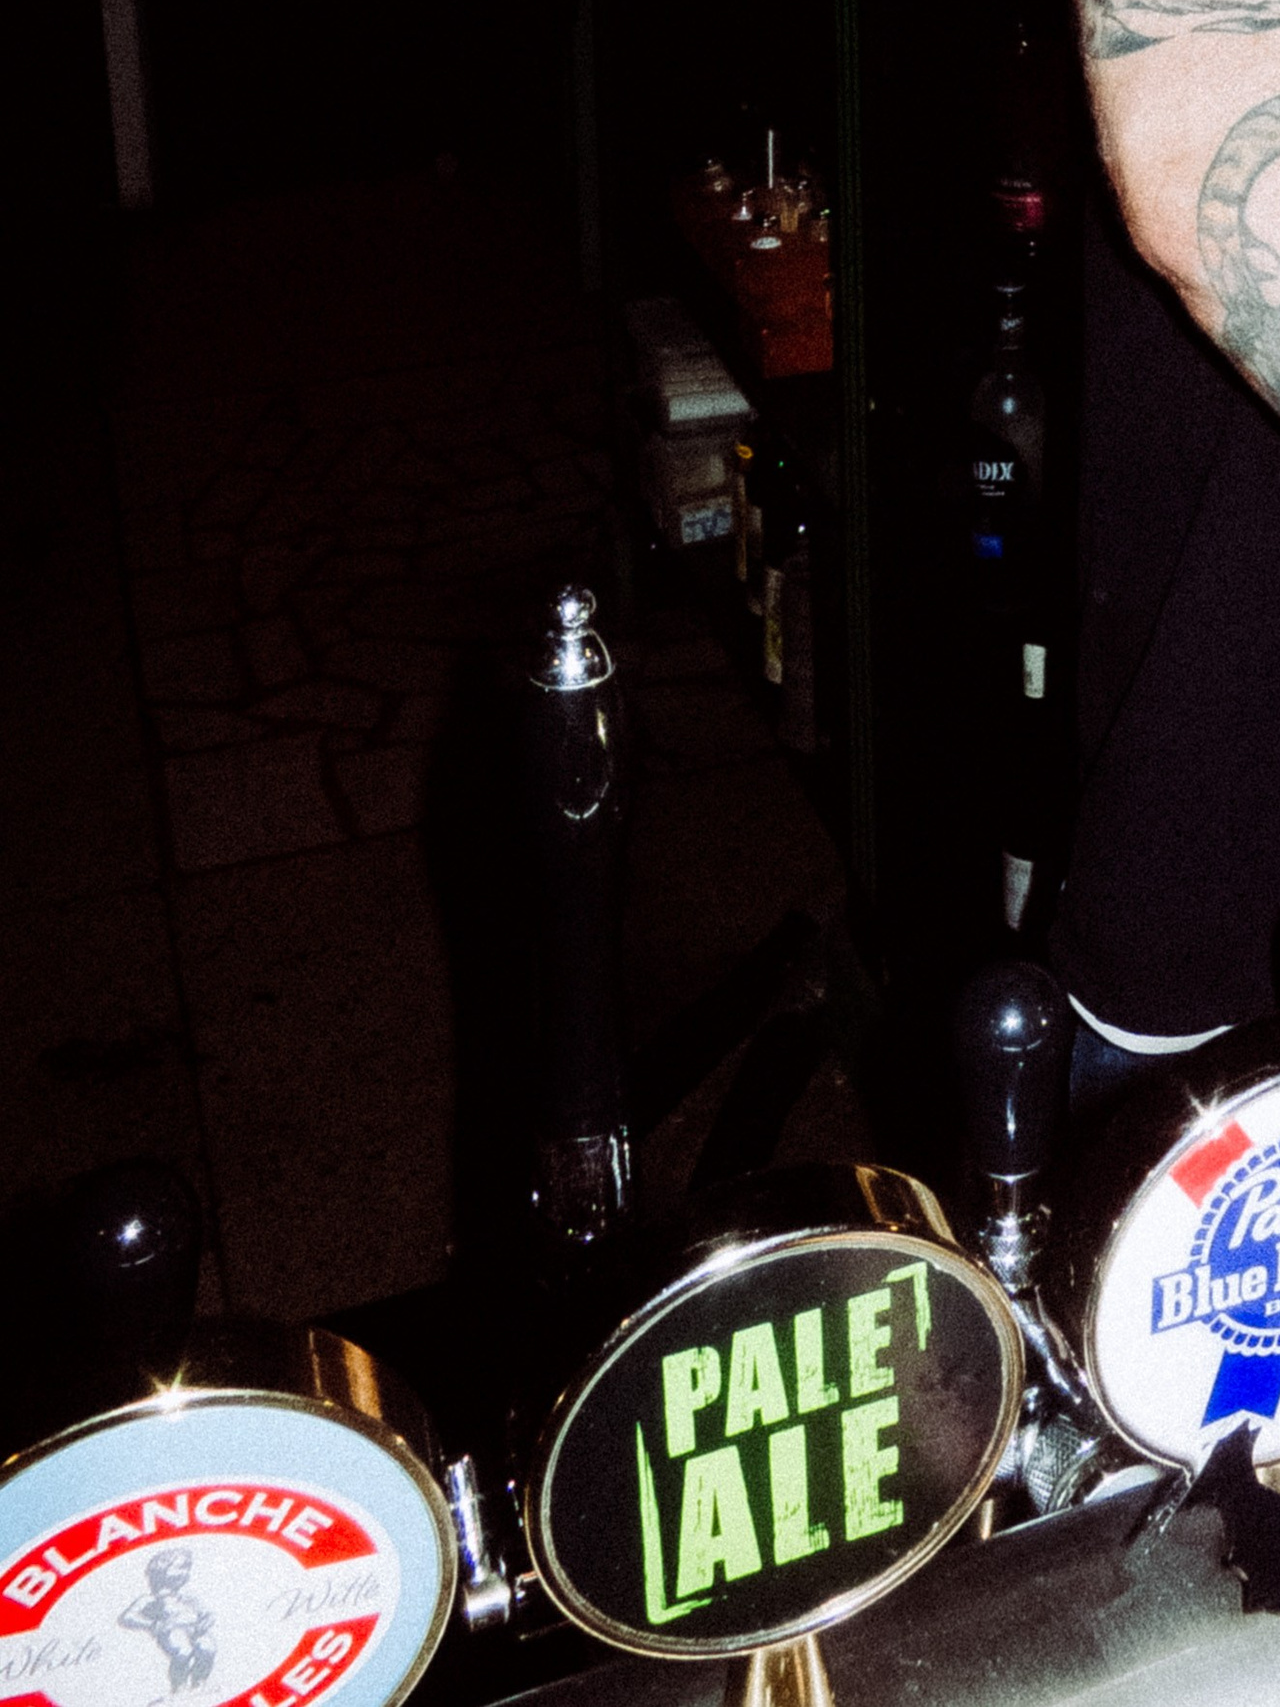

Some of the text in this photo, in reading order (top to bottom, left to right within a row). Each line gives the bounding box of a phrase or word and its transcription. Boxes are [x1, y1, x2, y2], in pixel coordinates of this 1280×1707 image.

[1156, 1259, 1267, 1331] Blue
[661, 1287, 896, 1459] PALE
[8, 1489, 334, 1610] BLANCHE
[675, 1394, 904, 1599] ALE
